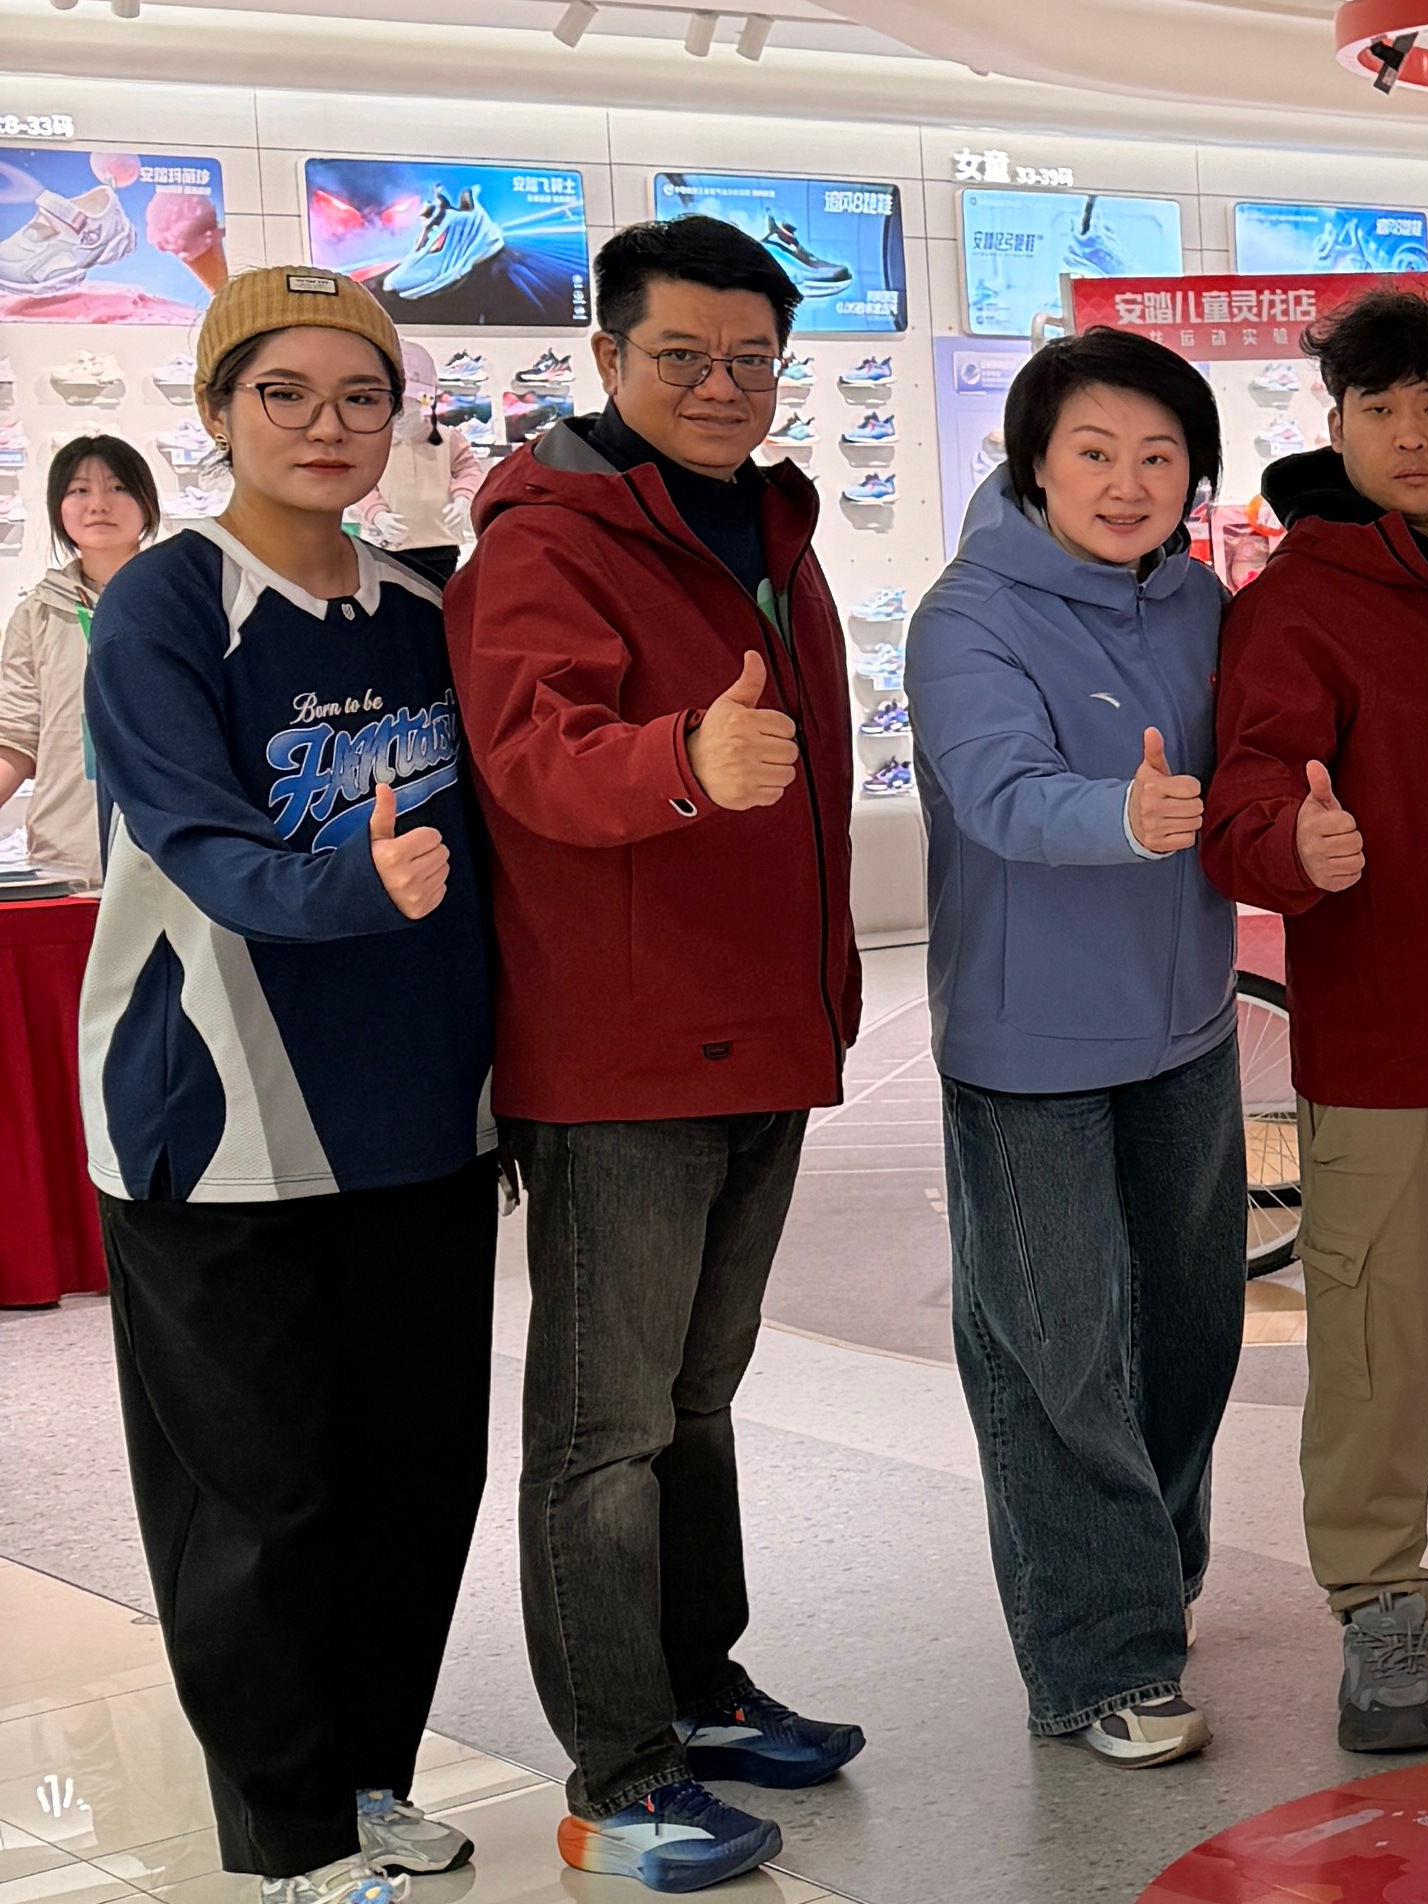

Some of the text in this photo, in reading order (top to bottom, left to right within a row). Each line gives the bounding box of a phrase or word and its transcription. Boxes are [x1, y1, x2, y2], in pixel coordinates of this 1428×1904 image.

[953, 147, 1011, 184] 女童
[1114, 289, 1317, 325] 安踏儿童灵龙店
[290, 688, 384, 725] Born to be
